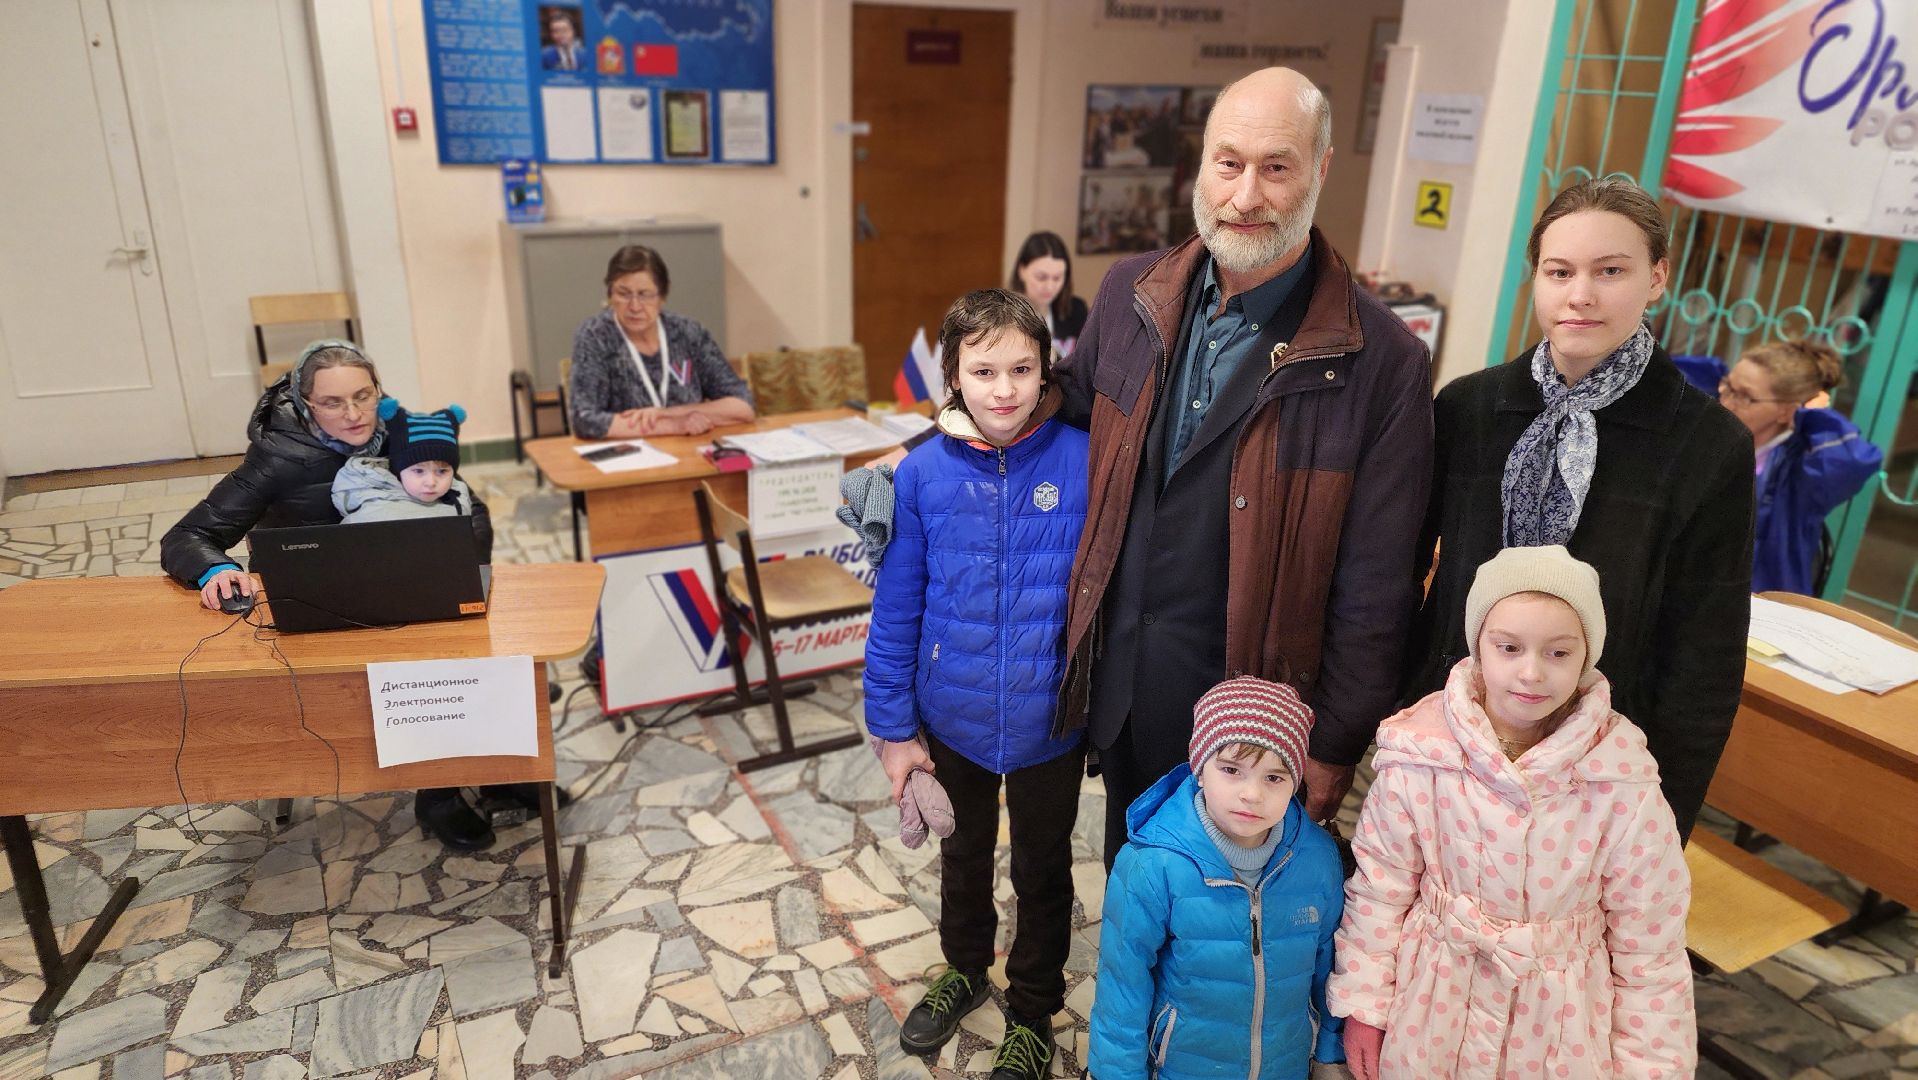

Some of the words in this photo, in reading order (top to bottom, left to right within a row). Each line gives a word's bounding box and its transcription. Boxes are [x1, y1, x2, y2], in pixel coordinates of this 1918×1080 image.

[281, 543, 320, 551] Lenovo
[813, 623, 870, 651] МАРТА
[380, 677, 480, 694] Дистанционное
[384, 694, 465, 710] Электронное
[386, 711, 466, 728] Голосование
